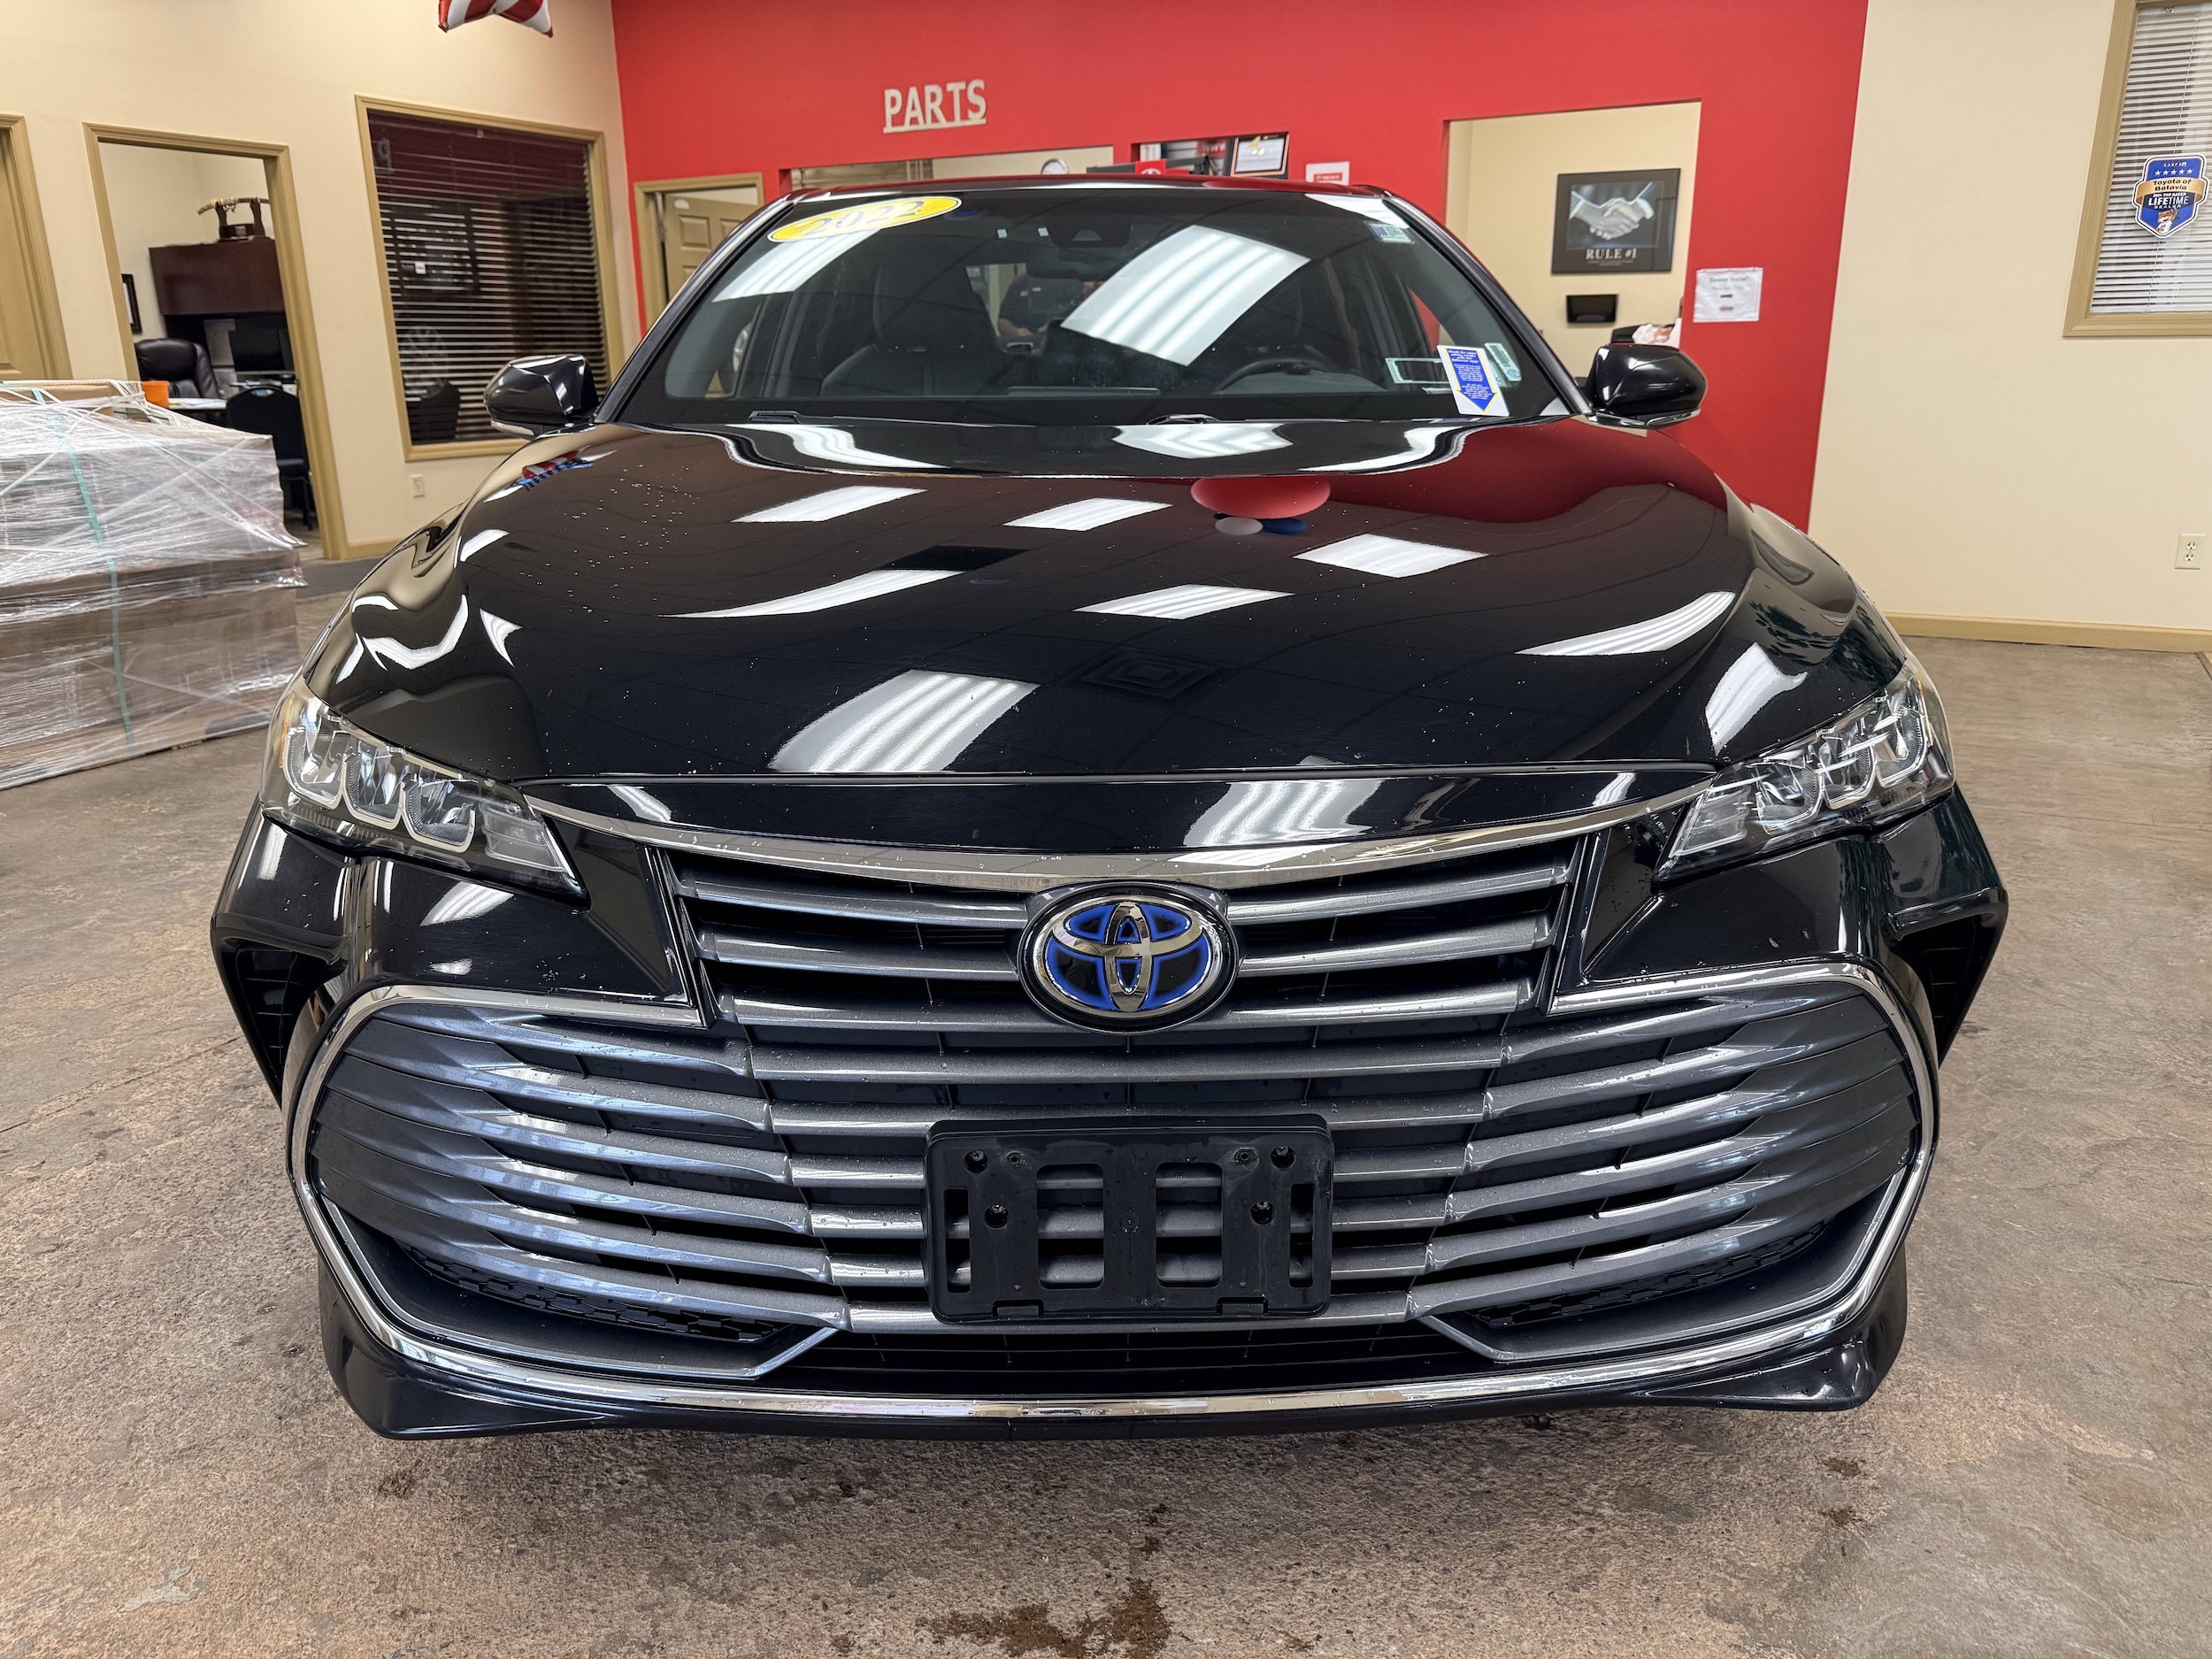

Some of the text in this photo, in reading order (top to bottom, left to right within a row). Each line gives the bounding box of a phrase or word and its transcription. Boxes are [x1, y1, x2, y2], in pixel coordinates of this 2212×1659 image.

[884, 79, 987, 130] PARTS
[2148, 196, 2189, 205] LIFETIME
[800, 200, 925, 236] 2022
[1586, 248, 1637, 259] RULE #1
